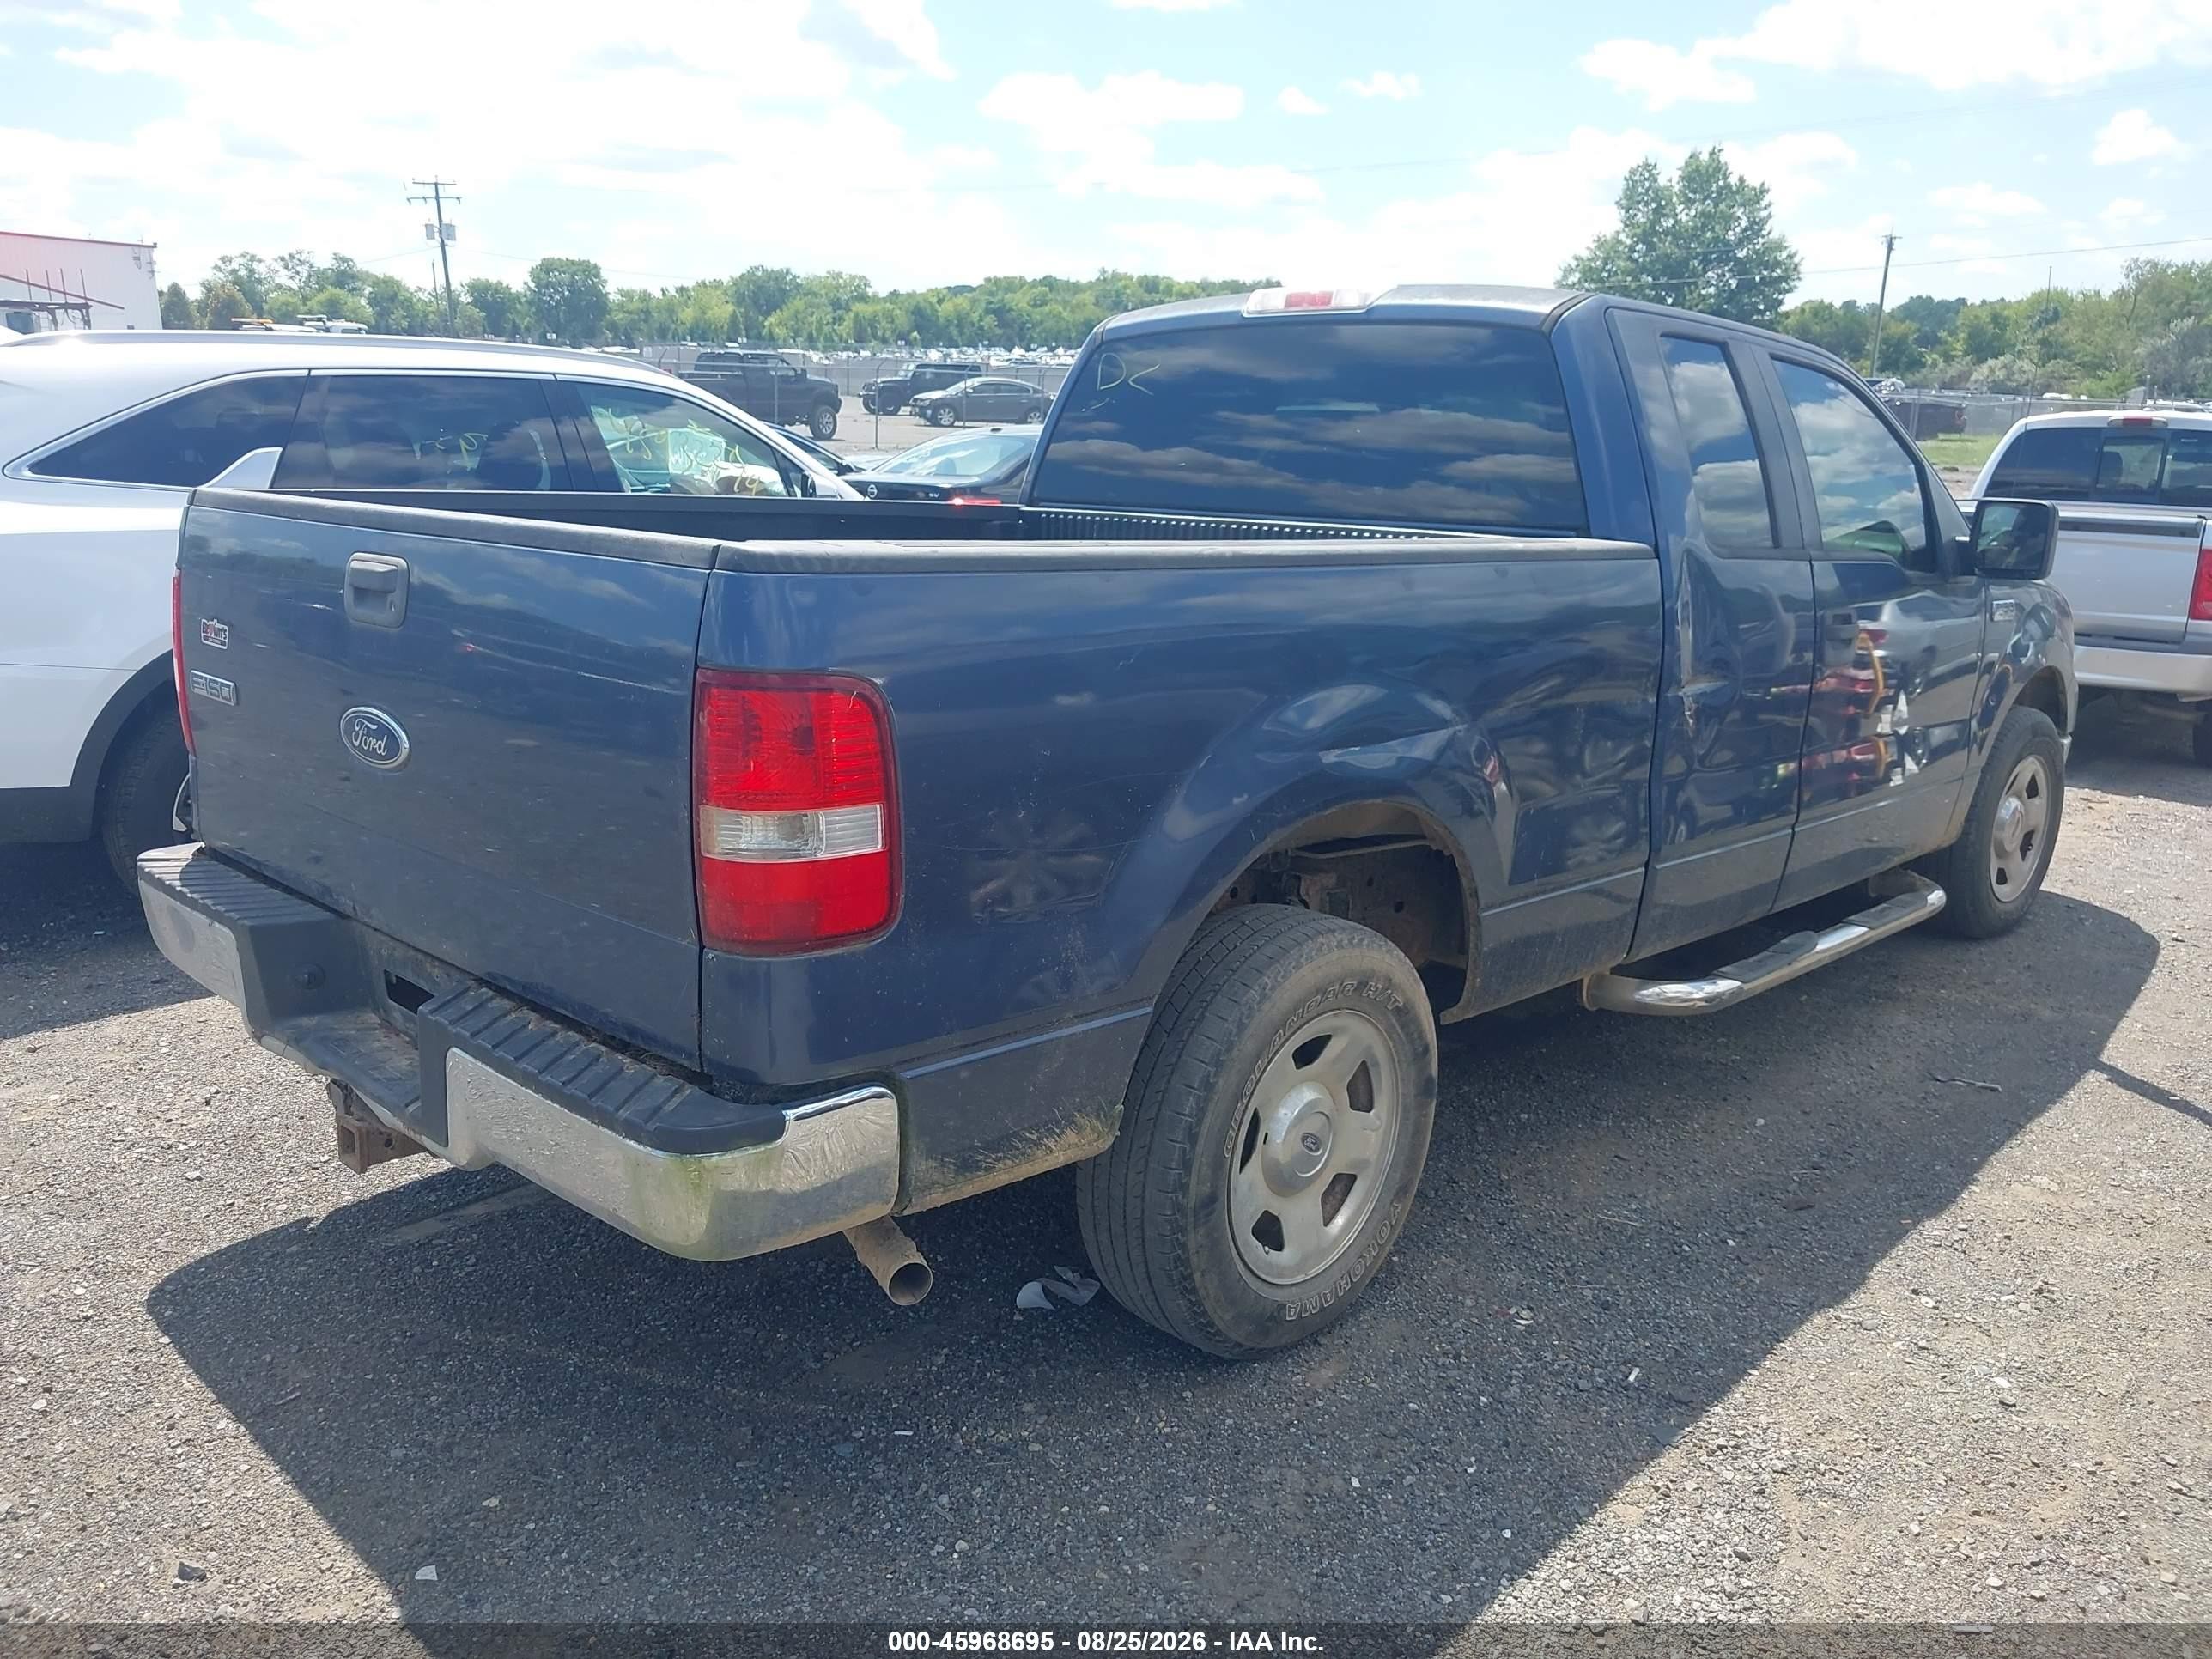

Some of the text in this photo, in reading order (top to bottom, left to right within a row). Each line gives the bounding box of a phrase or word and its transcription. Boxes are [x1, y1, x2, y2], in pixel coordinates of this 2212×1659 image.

[352, 718, 388, 756] Ford
[1361, 981, 1403, 1011] H/T
[1285, 1202, 1402, 1321] YOKOHAMA
